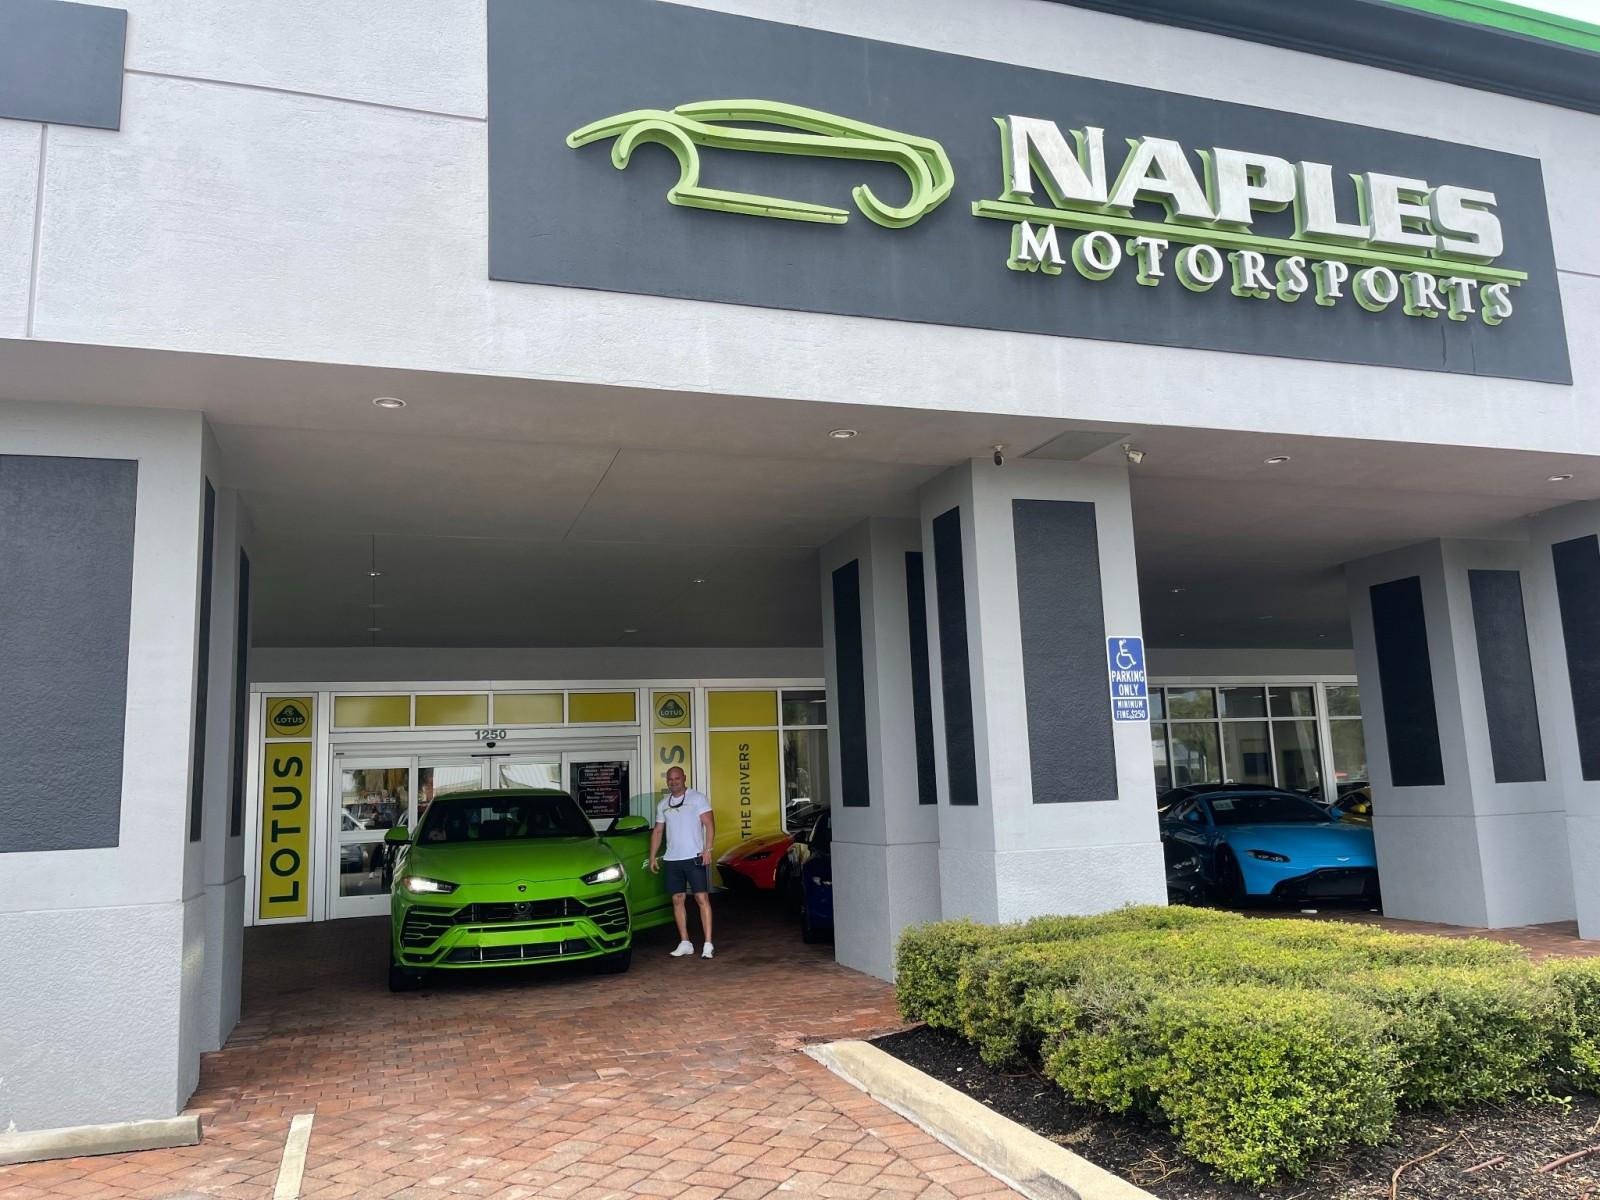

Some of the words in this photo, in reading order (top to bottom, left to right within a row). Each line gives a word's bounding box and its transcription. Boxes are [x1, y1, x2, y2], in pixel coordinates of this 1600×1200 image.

[994, 113, 1504, 265] NAPLES
[1007, 220, 1514, 325] MOTORSPORTS
[1111, 670, 1145, 682] PARKING
[1118, 684, 1139, 696] ONLY
[1116, 710, 1130, 719] FINE
[1117, 700, 1143, 709] MINIMUM
[474, 729, 507, 740] 1250
[738, 743, 751, 804] DRIVERS
[268, 756, 304, 904] LOTUS
[741, 809, 752, 840] THE
